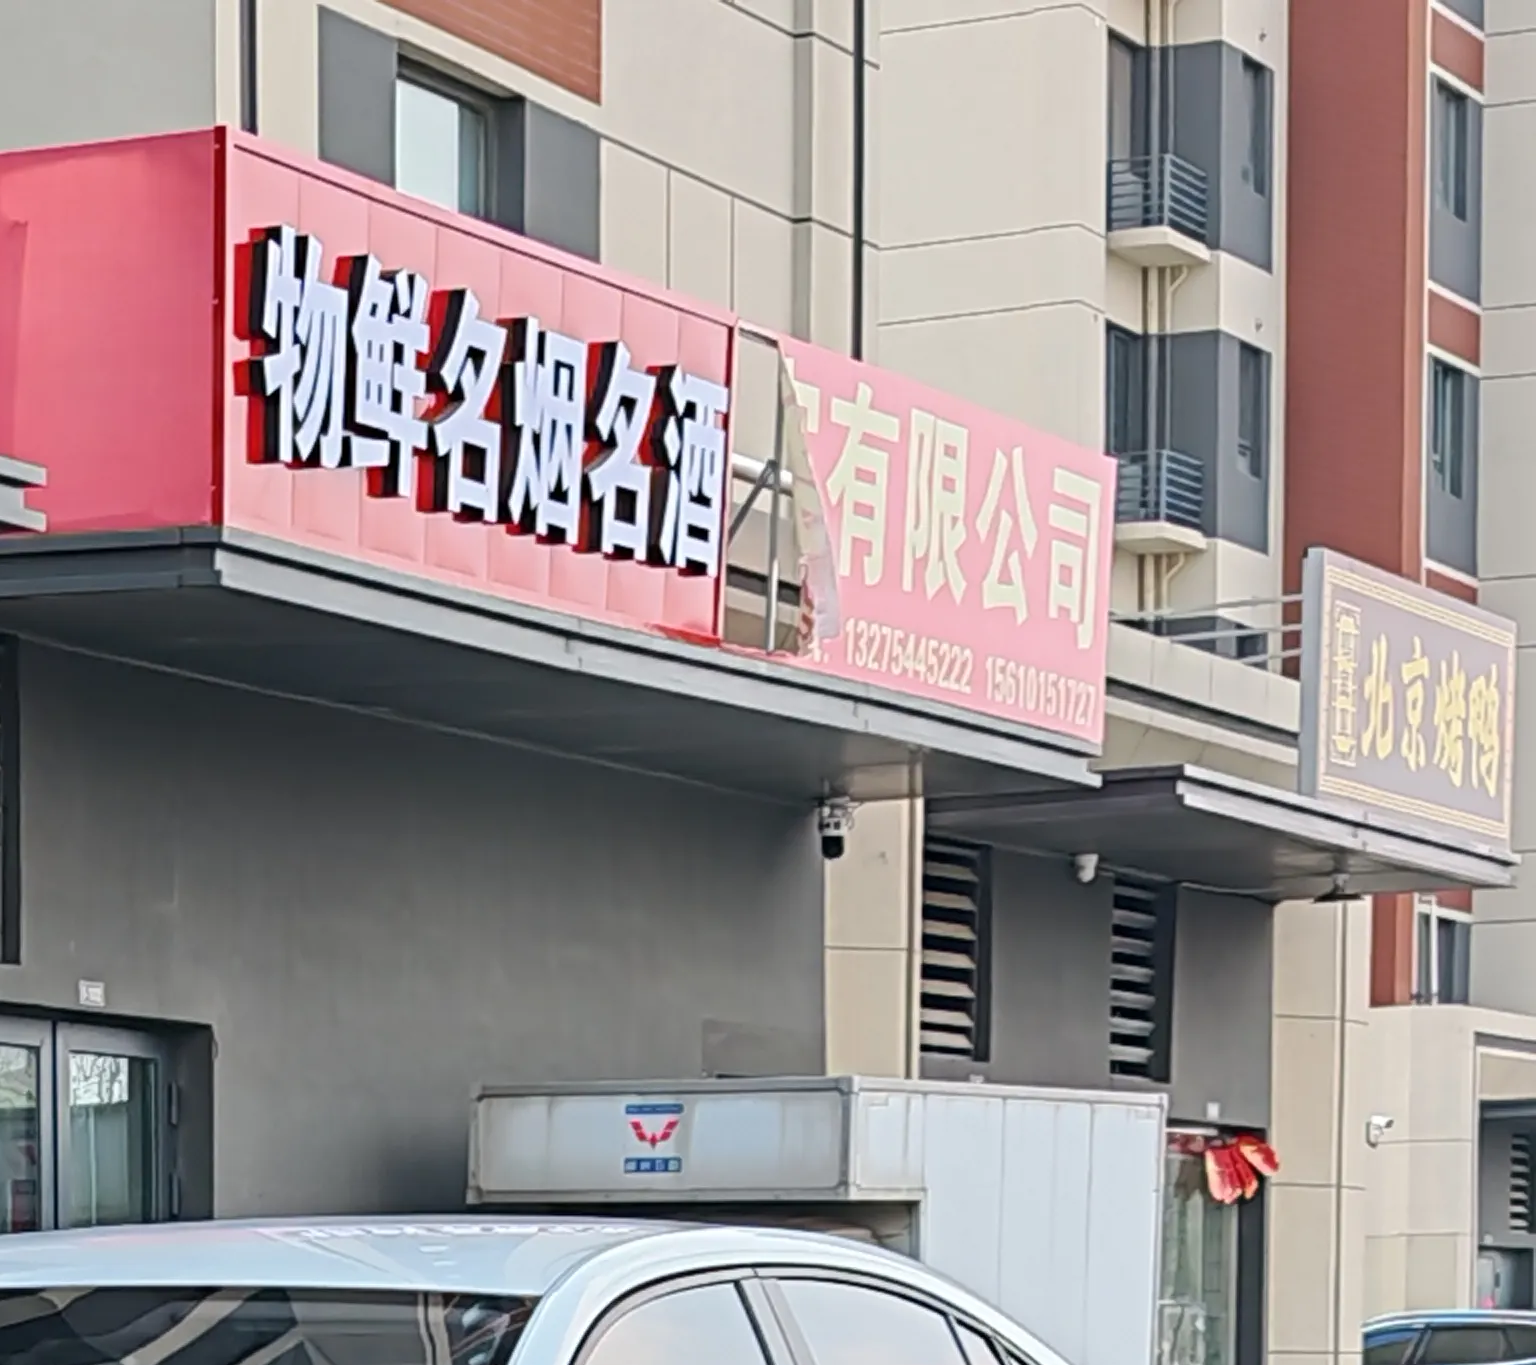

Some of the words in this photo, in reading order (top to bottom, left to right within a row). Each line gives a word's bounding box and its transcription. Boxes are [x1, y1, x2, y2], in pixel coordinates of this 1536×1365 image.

[260, 224, 729, 578] 物鲜名烟名酒
[845, 617, 974, 695] 13275445222
[985, 655, 1096, 728] 15610151727
